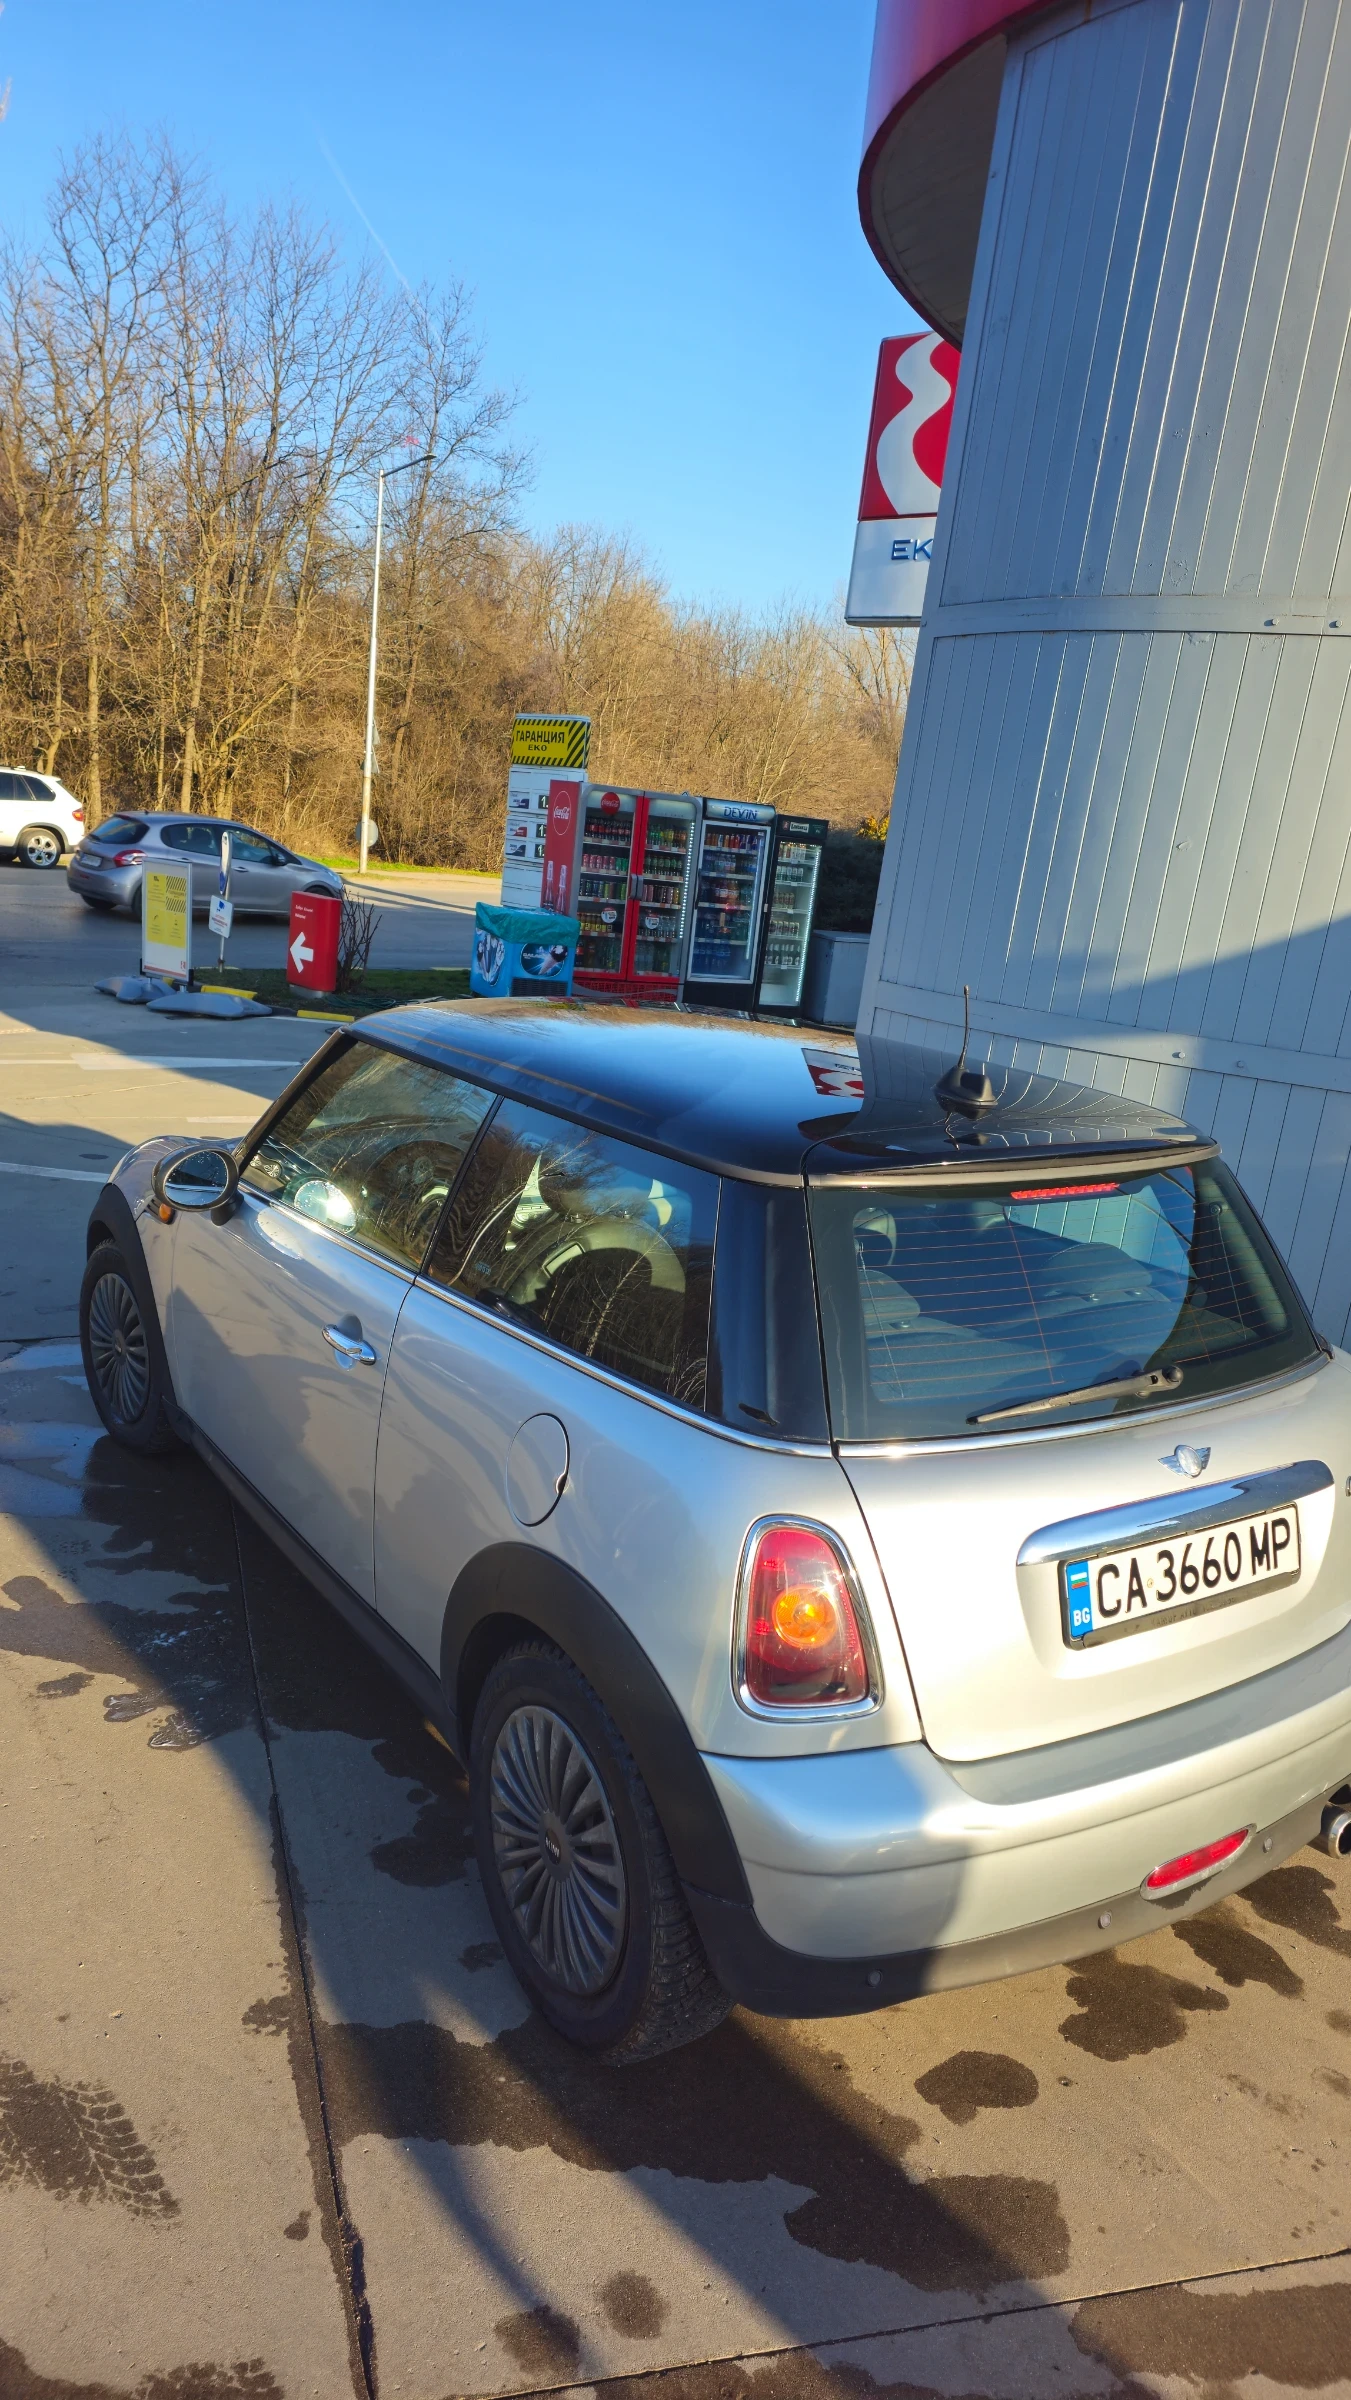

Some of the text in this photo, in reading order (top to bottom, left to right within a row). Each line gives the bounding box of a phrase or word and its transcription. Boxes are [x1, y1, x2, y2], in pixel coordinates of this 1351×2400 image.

[515, 730, 566, 744] ГАРАНЦИЯ
[723, 805, 758, 820] DEVIN
[1073, 1608, 1091, 1627] BG
